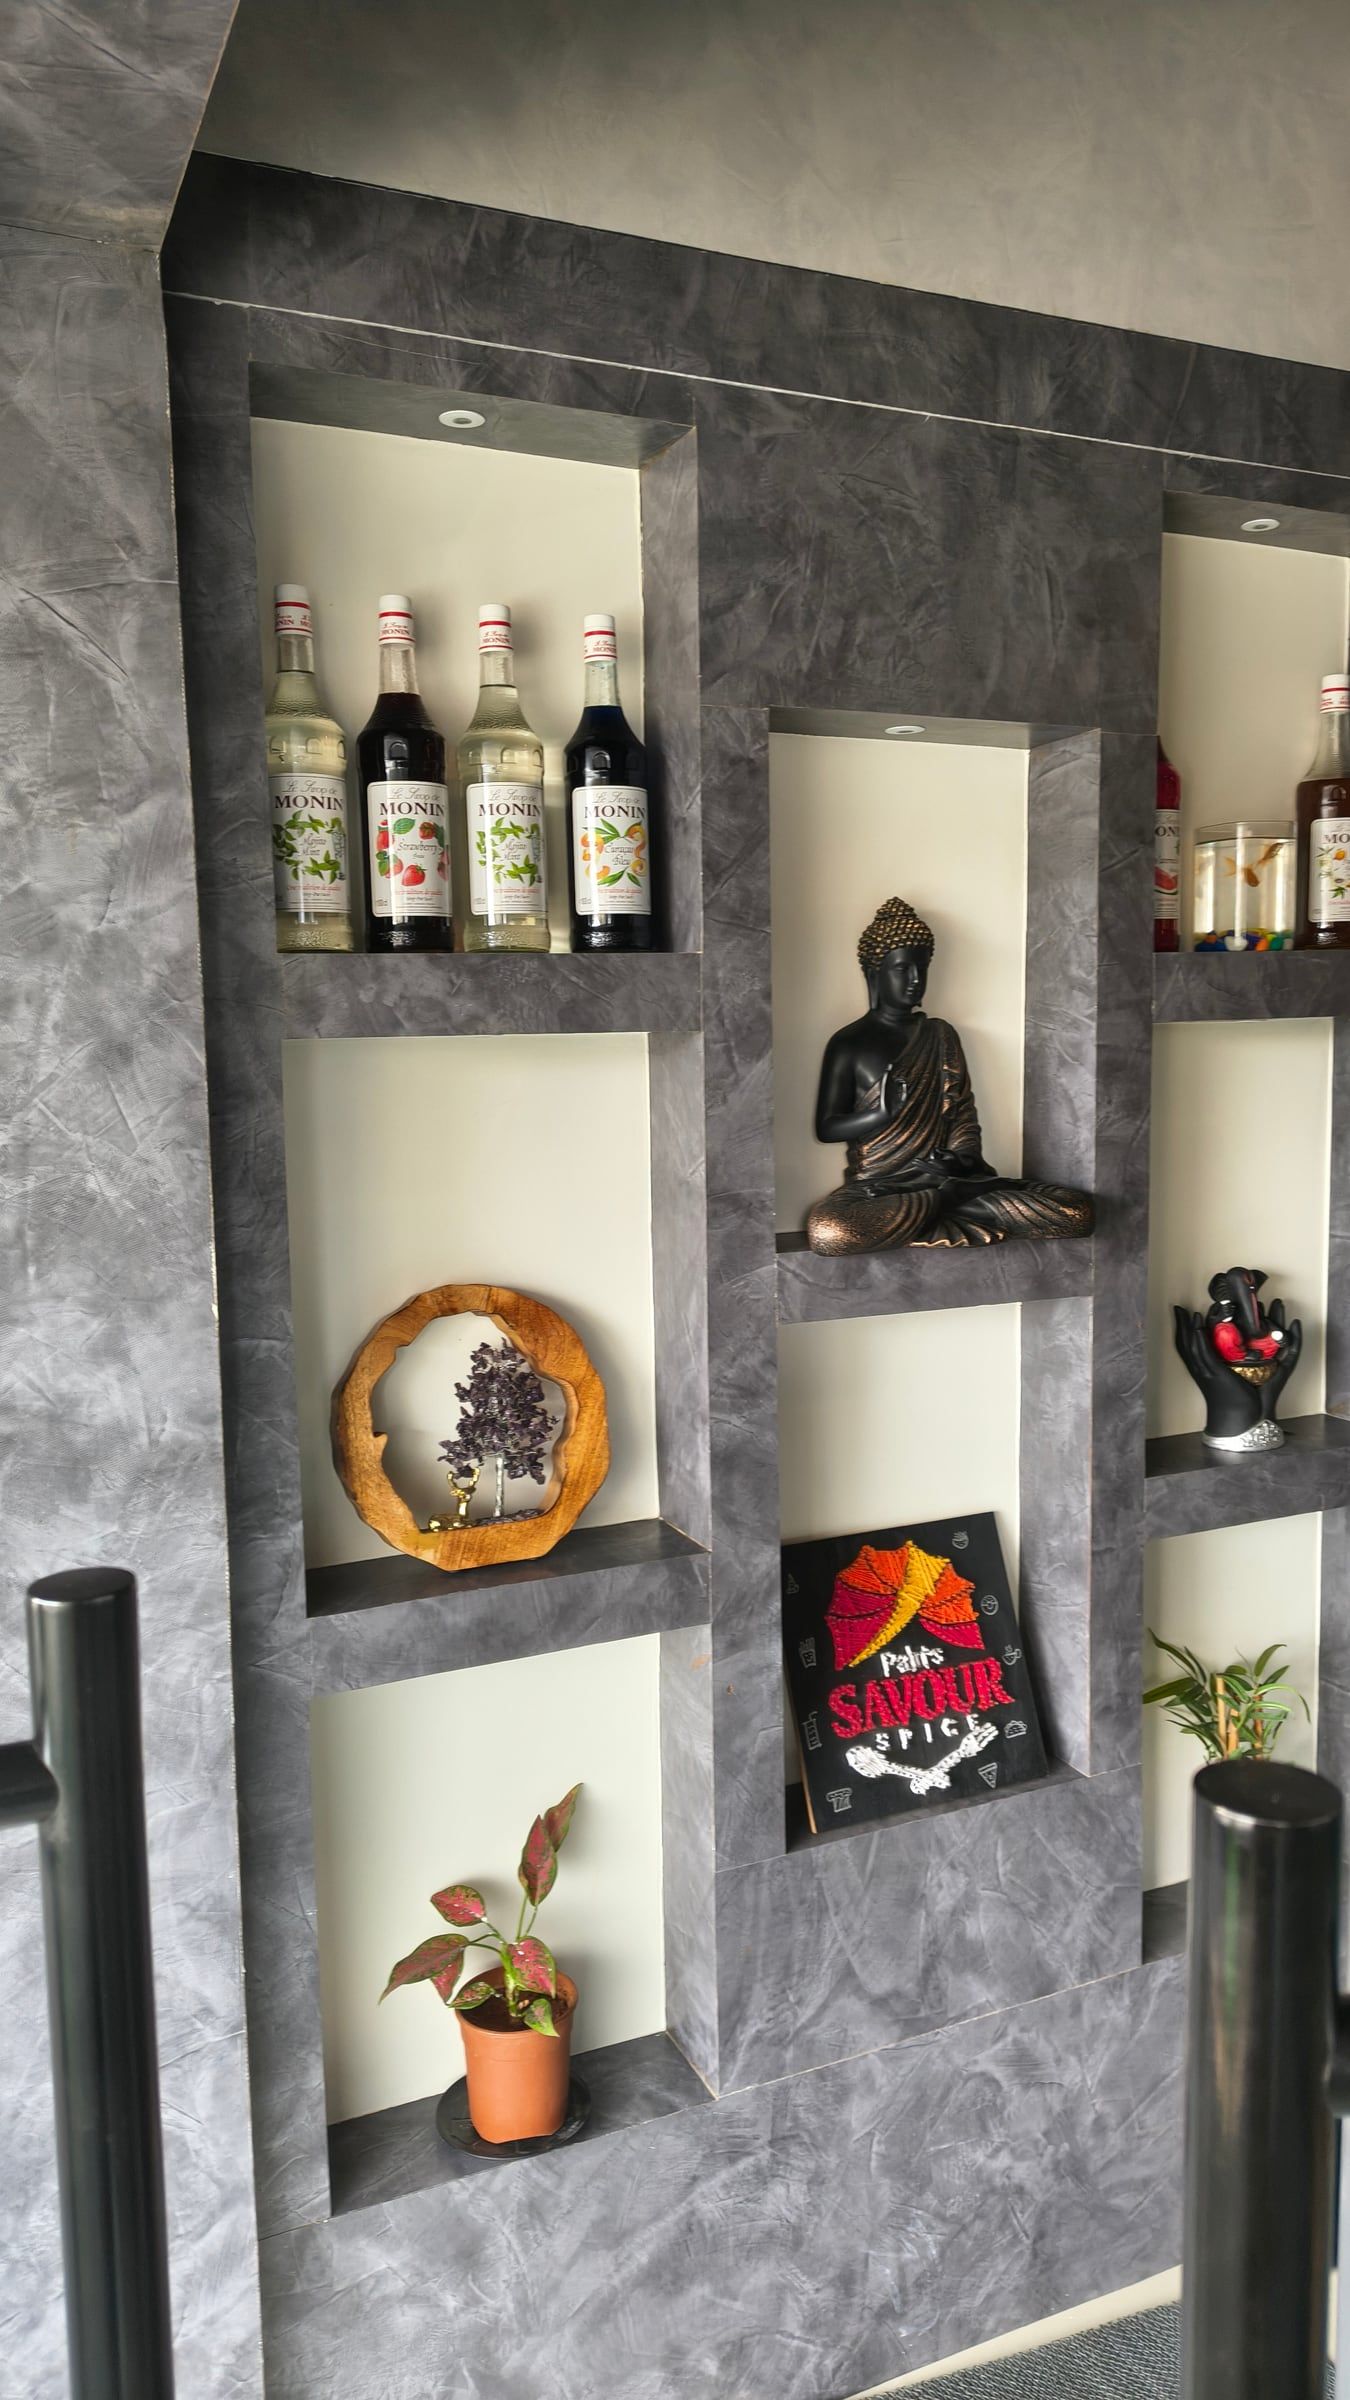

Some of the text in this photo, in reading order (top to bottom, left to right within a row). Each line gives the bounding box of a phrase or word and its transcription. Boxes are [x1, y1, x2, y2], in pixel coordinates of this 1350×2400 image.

[275, 795, 343, 810] MONIN
[380, 801, 444, 816] MONIN
[478, 803, 541, 817] MONIN
[584, 805, 646, 819] MONIN
[828, 1657, 1015, 1739] SAVOUR
[876, 1713, 980, 1751] SPICE
